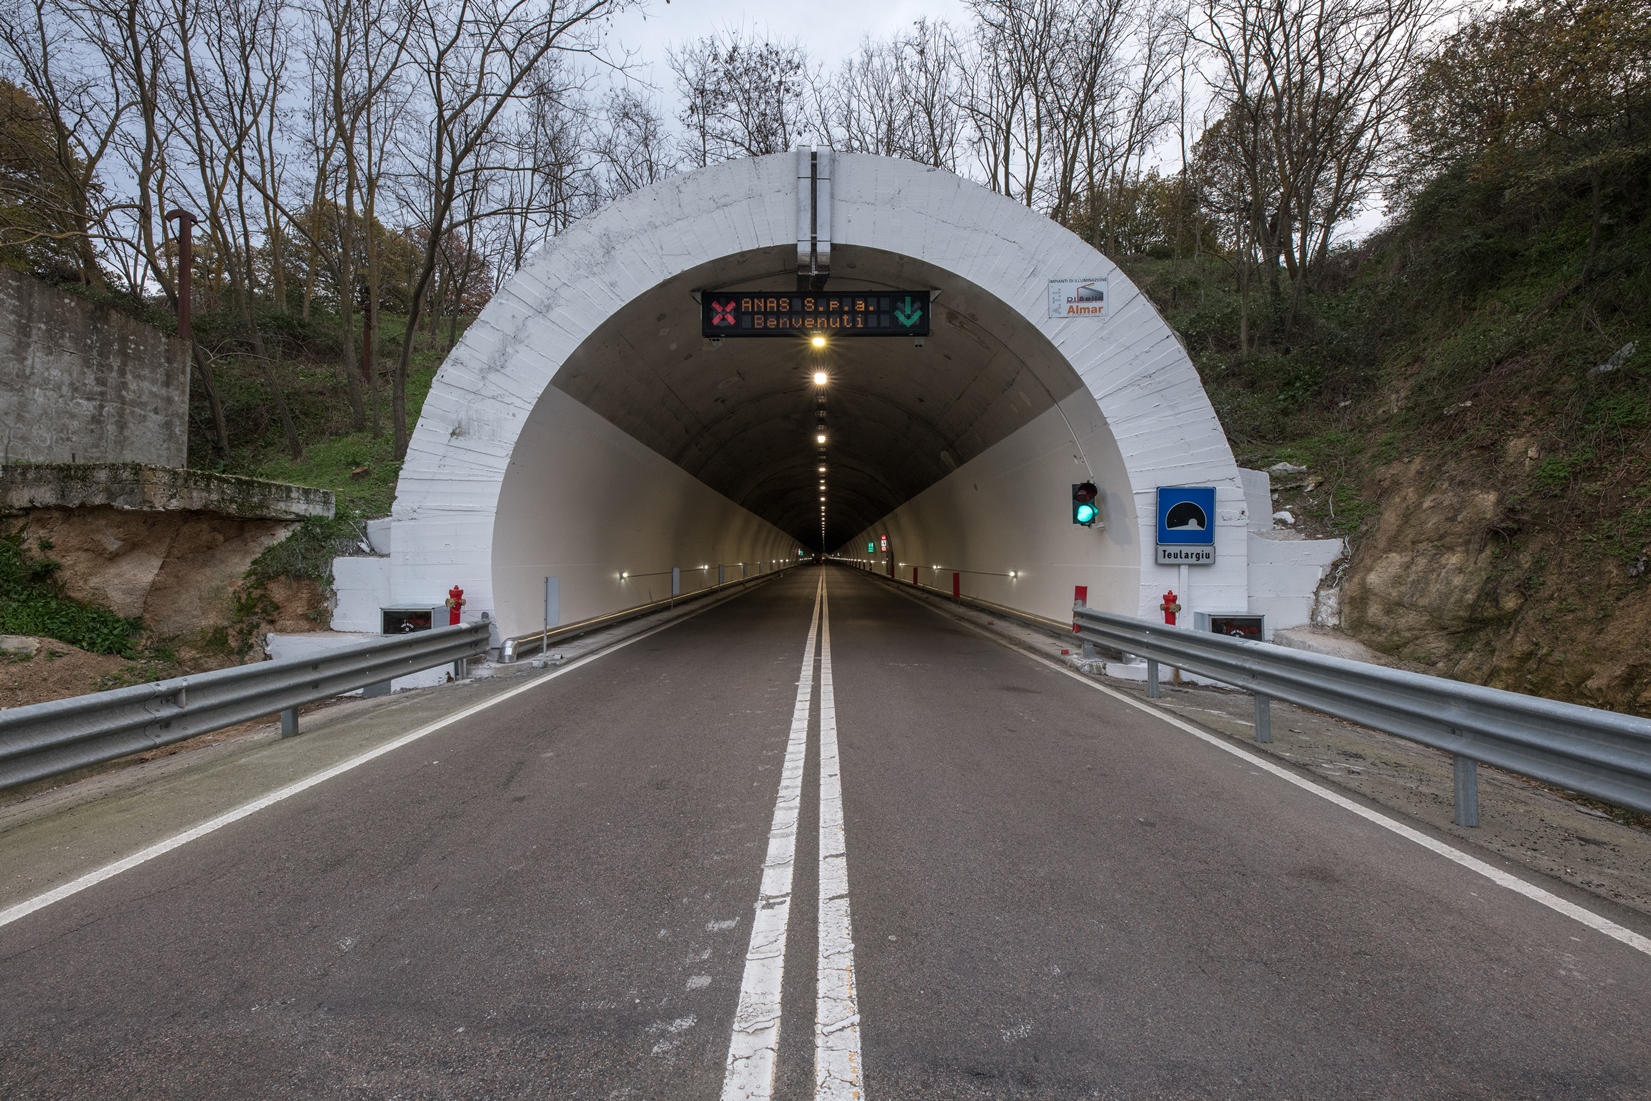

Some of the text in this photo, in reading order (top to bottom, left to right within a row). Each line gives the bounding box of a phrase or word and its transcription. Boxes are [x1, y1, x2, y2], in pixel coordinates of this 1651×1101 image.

[741, 298, 790, 312] ANAS
[1067, 305, 1103, 314] Almar
[754, 314, 864, 328] Benvenuti
[1162, 549, 1210, 561] Teulargiu
